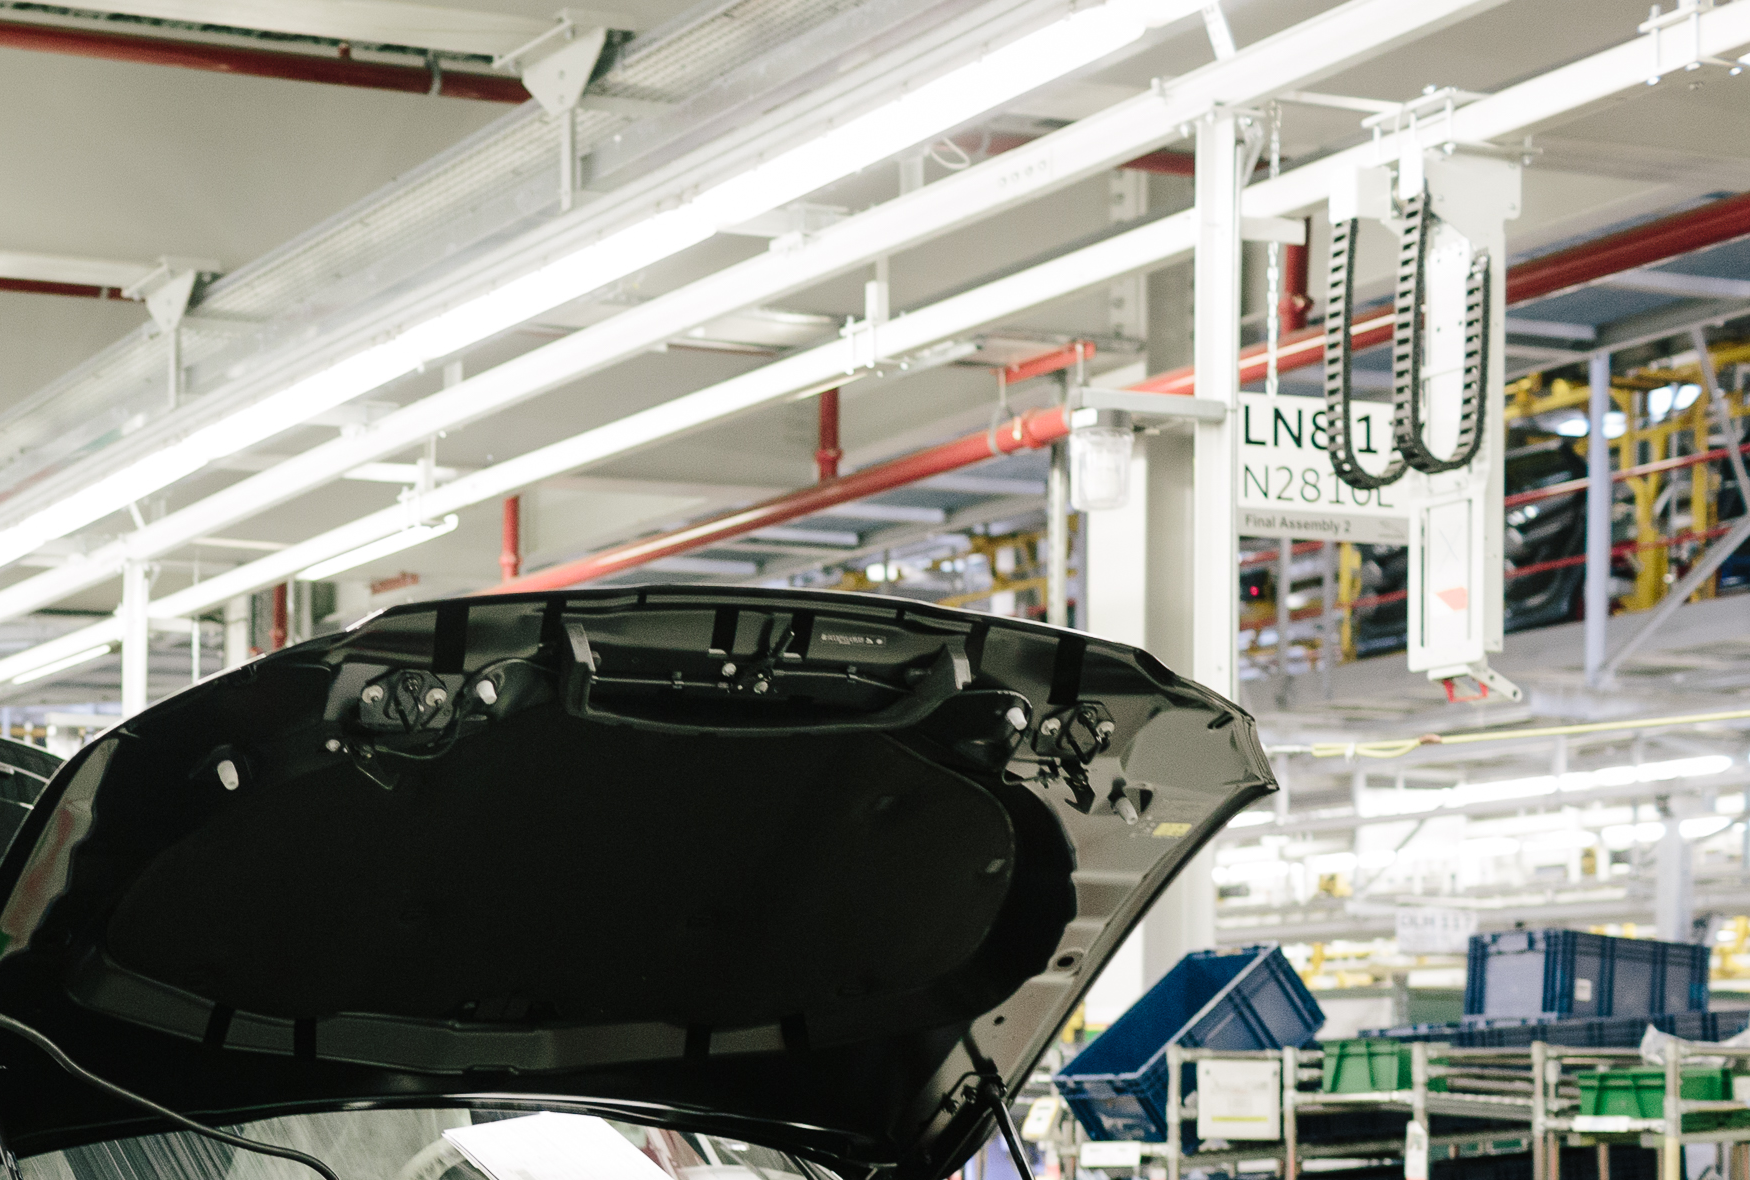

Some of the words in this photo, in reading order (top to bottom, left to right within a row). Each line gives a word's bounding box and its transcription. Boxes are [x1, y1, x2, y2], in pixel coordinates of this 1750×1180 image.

[1245, 514, 1275, 528] Final
[1279, 517, 1339, 536] Assembly
[1343, 522, 1351, 532] 2
